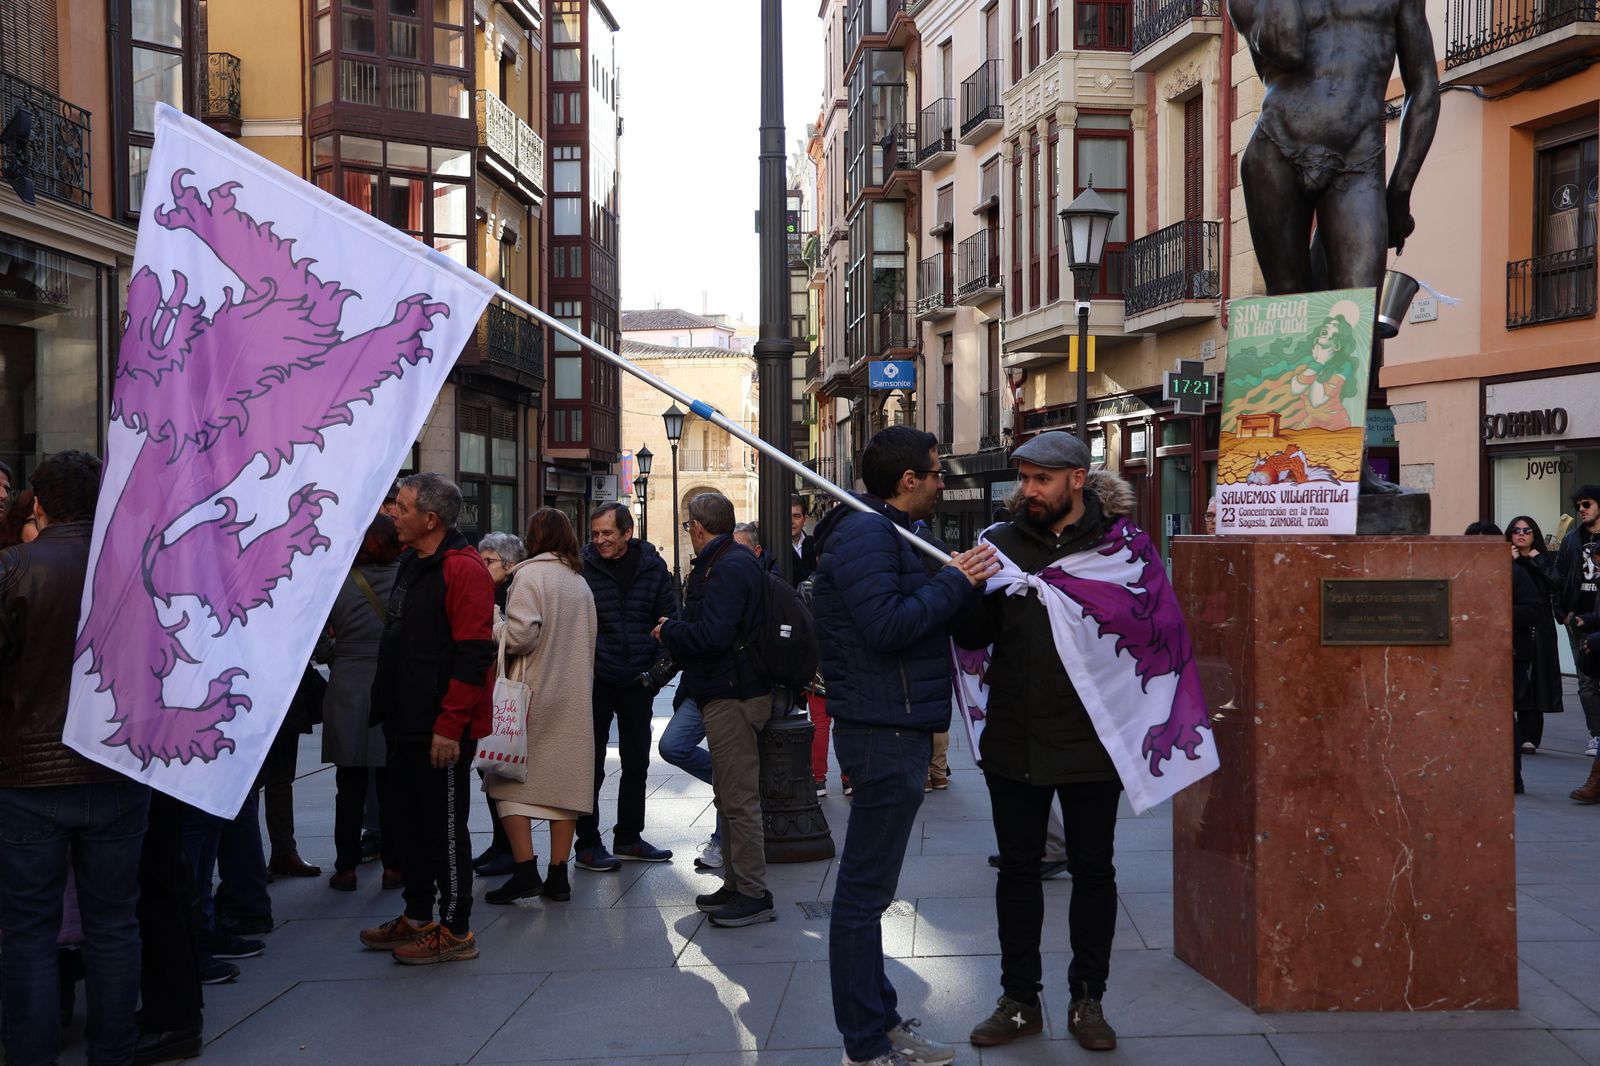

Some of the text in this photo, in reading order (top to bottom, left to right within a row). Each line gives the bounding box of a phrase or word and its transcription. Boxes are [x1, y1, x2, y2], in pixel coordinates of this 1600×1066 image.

[1236, 300, 1308, 322] SIN AGUA
[1234, 318, 1308, 338] NO HAY VIDA
[1172, 378, 1209, 395] 17:21
[1482, 408, 1568, 440] SOBRINO
[1526, 458, 1574, 480] joyeros
[1222, 486, 1349, 504] SALVEMOS VILLAFÁFILA
[1222, 508, 1235, 522] 23
[1239, 507, 1286, 516] Concentración
[1301, 507, 1307, 516] la
[1310, 507, 1329, 516] Plaza
[1239, 518, 1267, 528] Sagasta,
[1270, 518, 1304, 527] ZAMORA,
